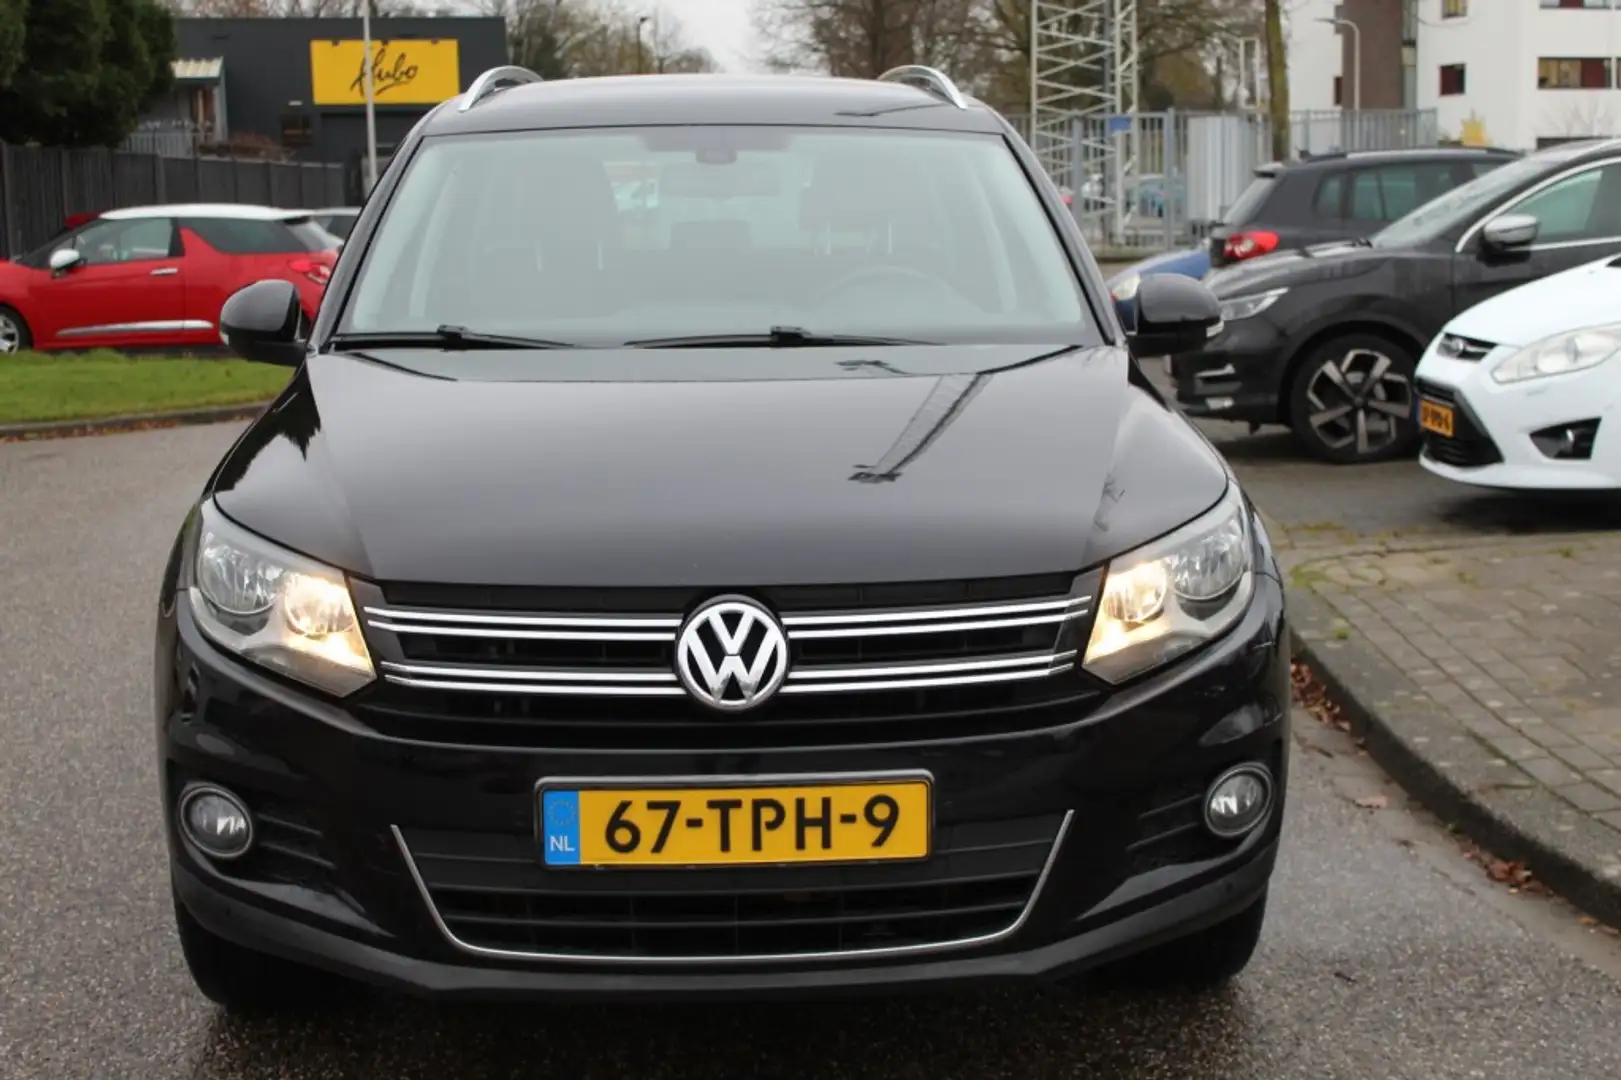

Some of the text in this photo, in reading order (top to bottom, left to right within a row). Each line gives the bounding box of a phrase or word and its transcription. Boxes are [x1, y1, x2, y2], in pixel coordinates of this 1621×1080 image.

[679, 601, 786, 707] VW
[549, 794, 900, 854] NL 67-TPH-9
